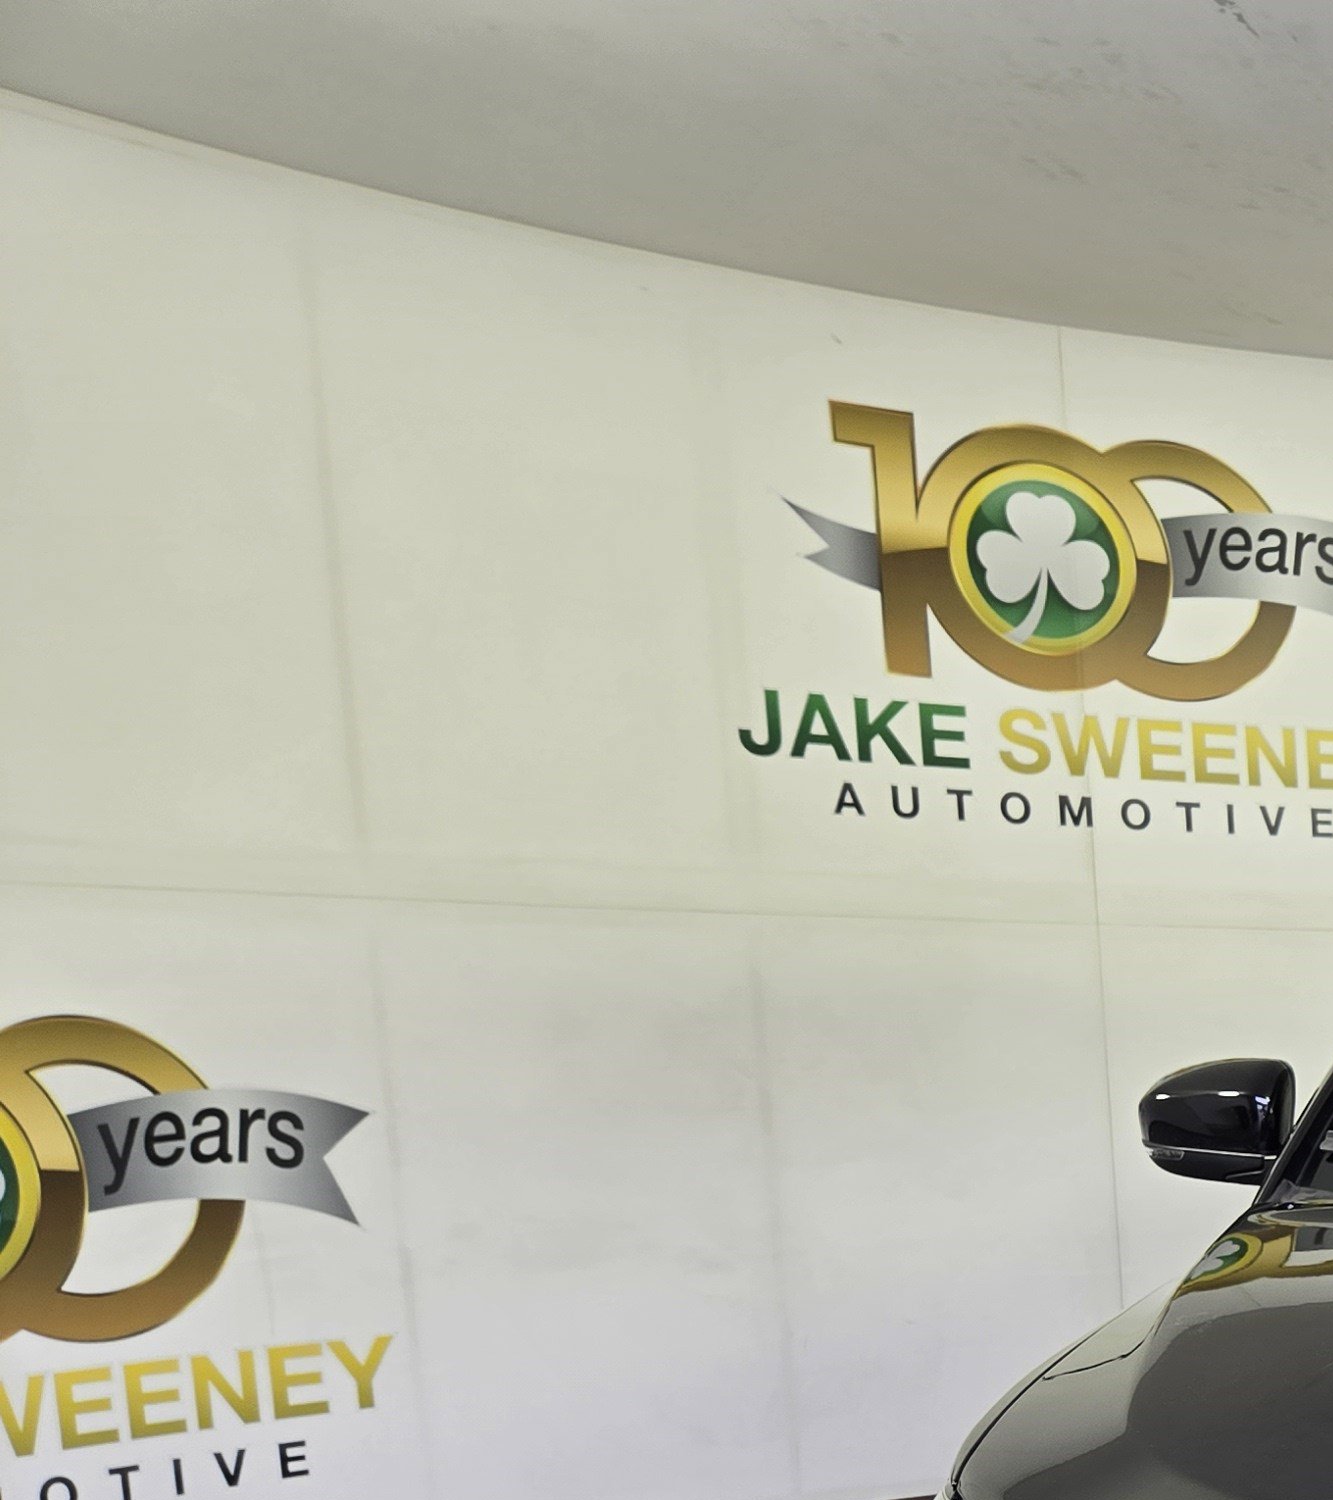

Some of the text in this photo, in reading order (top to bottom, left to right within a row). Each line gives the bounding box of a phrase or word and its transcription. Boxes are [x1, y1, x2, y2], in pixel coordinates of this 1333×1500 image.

[829, 399, 1296, 701] 100
[738, 690, 971, 770] JAKE
[834, 783, 1333, 839] AUTOMOTIVE
[97, 1106, 305, 1196] years
